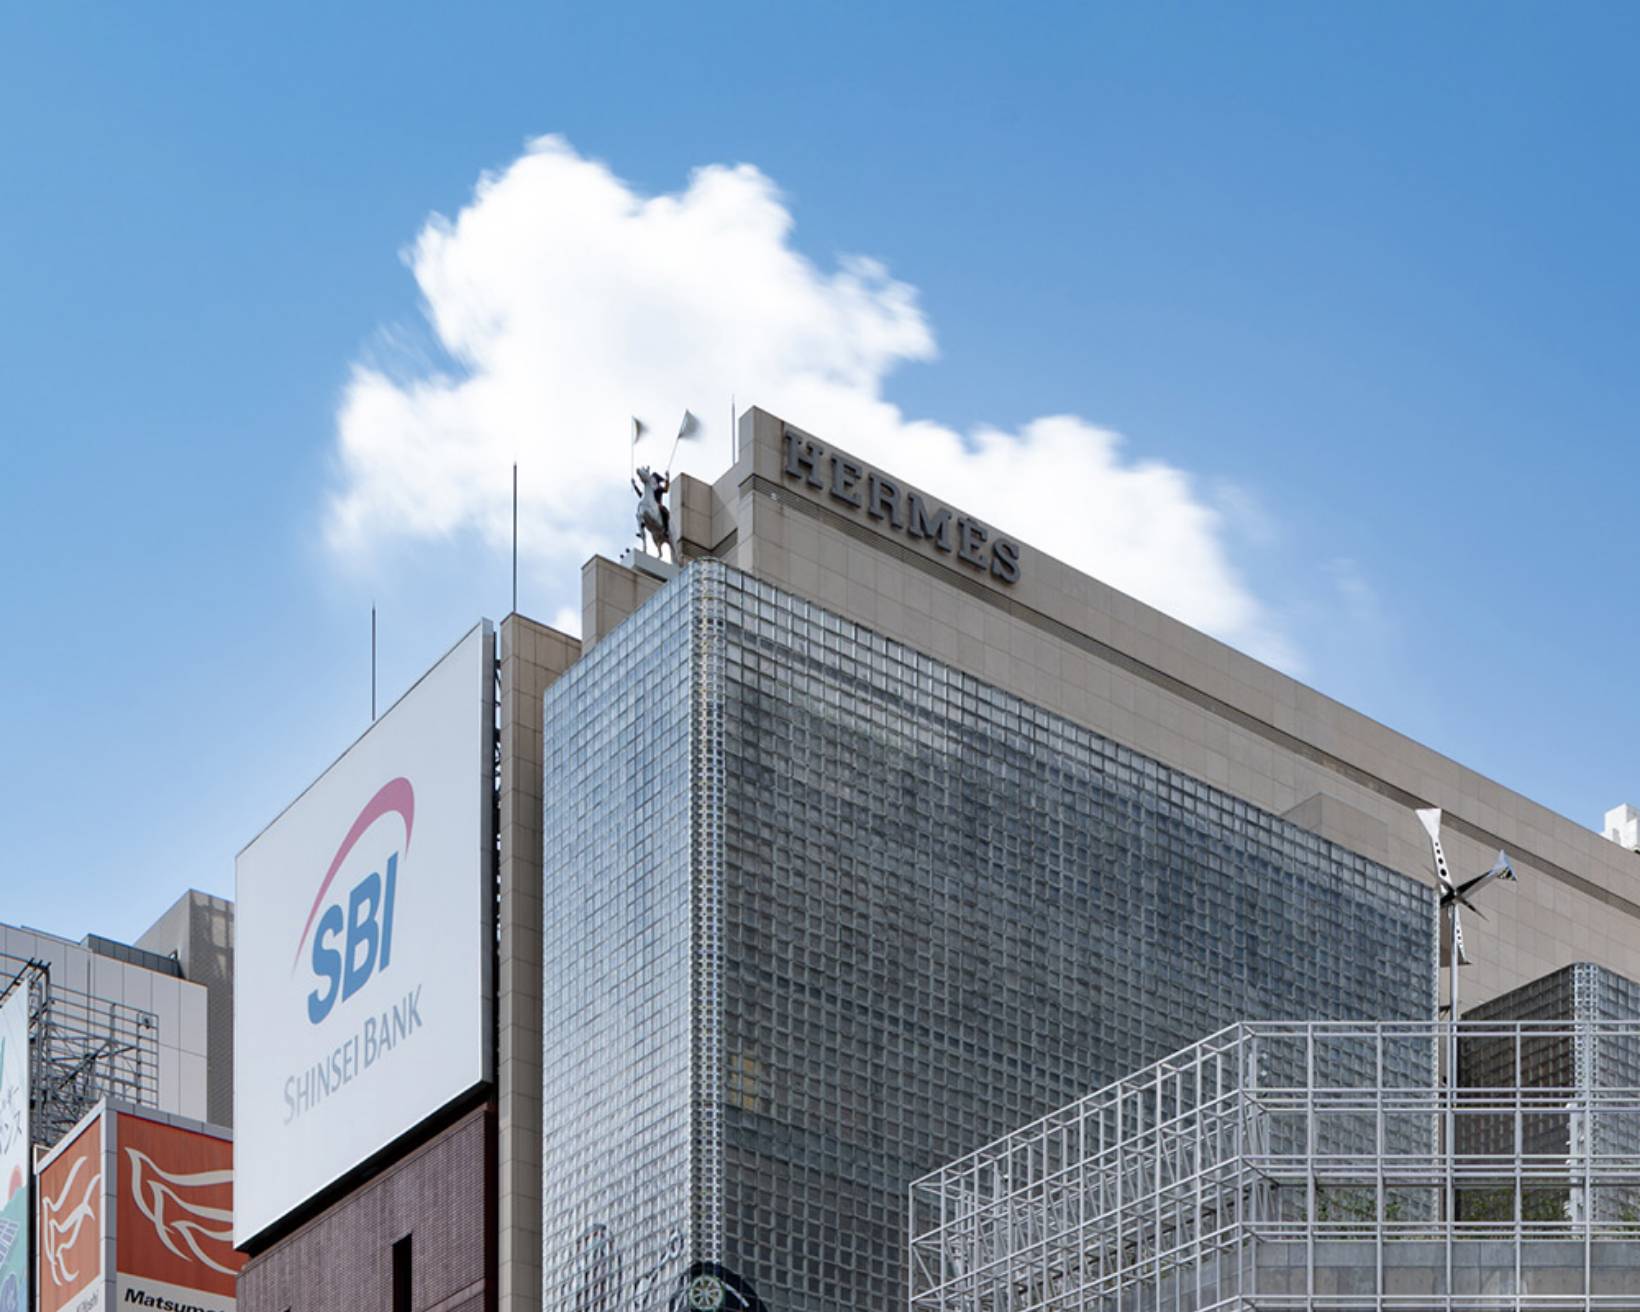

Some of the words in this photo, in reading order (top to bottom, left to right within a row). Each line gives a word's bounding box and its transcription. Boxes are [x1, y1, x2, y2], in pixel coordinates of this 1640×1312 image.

[784, 430, 1021, 584] HERMÈS
[307, 851, 399, 1025] SBI
[283, 1035, 359, 1126] SHINSEI
[363, 983, 423, 1070] BANK
